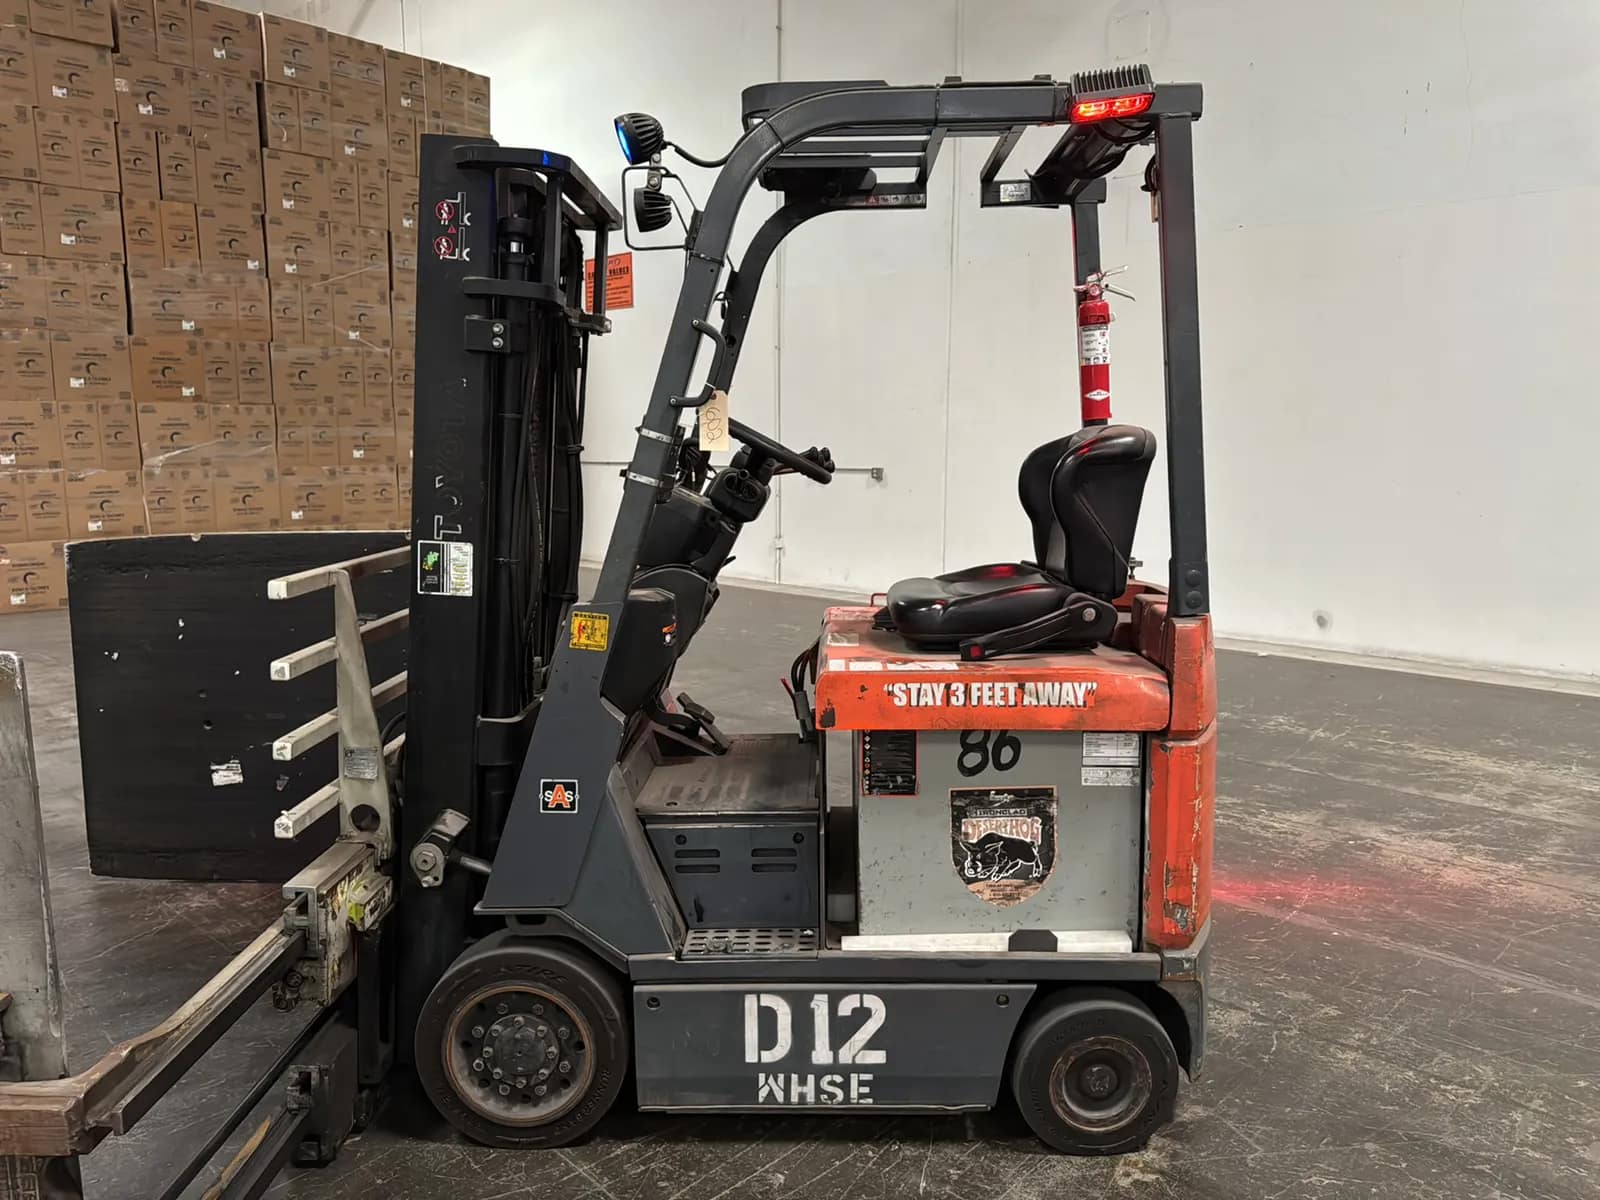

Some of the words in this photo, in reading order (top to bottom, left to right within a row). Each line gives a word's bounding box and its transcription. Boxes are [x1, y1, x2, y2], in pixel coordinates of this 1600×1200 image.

[950, 682, 967, 706] 3
[971, 682, 1019, 706] FEET
[957, 729, 1022, 777] 86
[544, 784, 574, 808] SAS
[758, 1072, 874, 1104] WHSE
